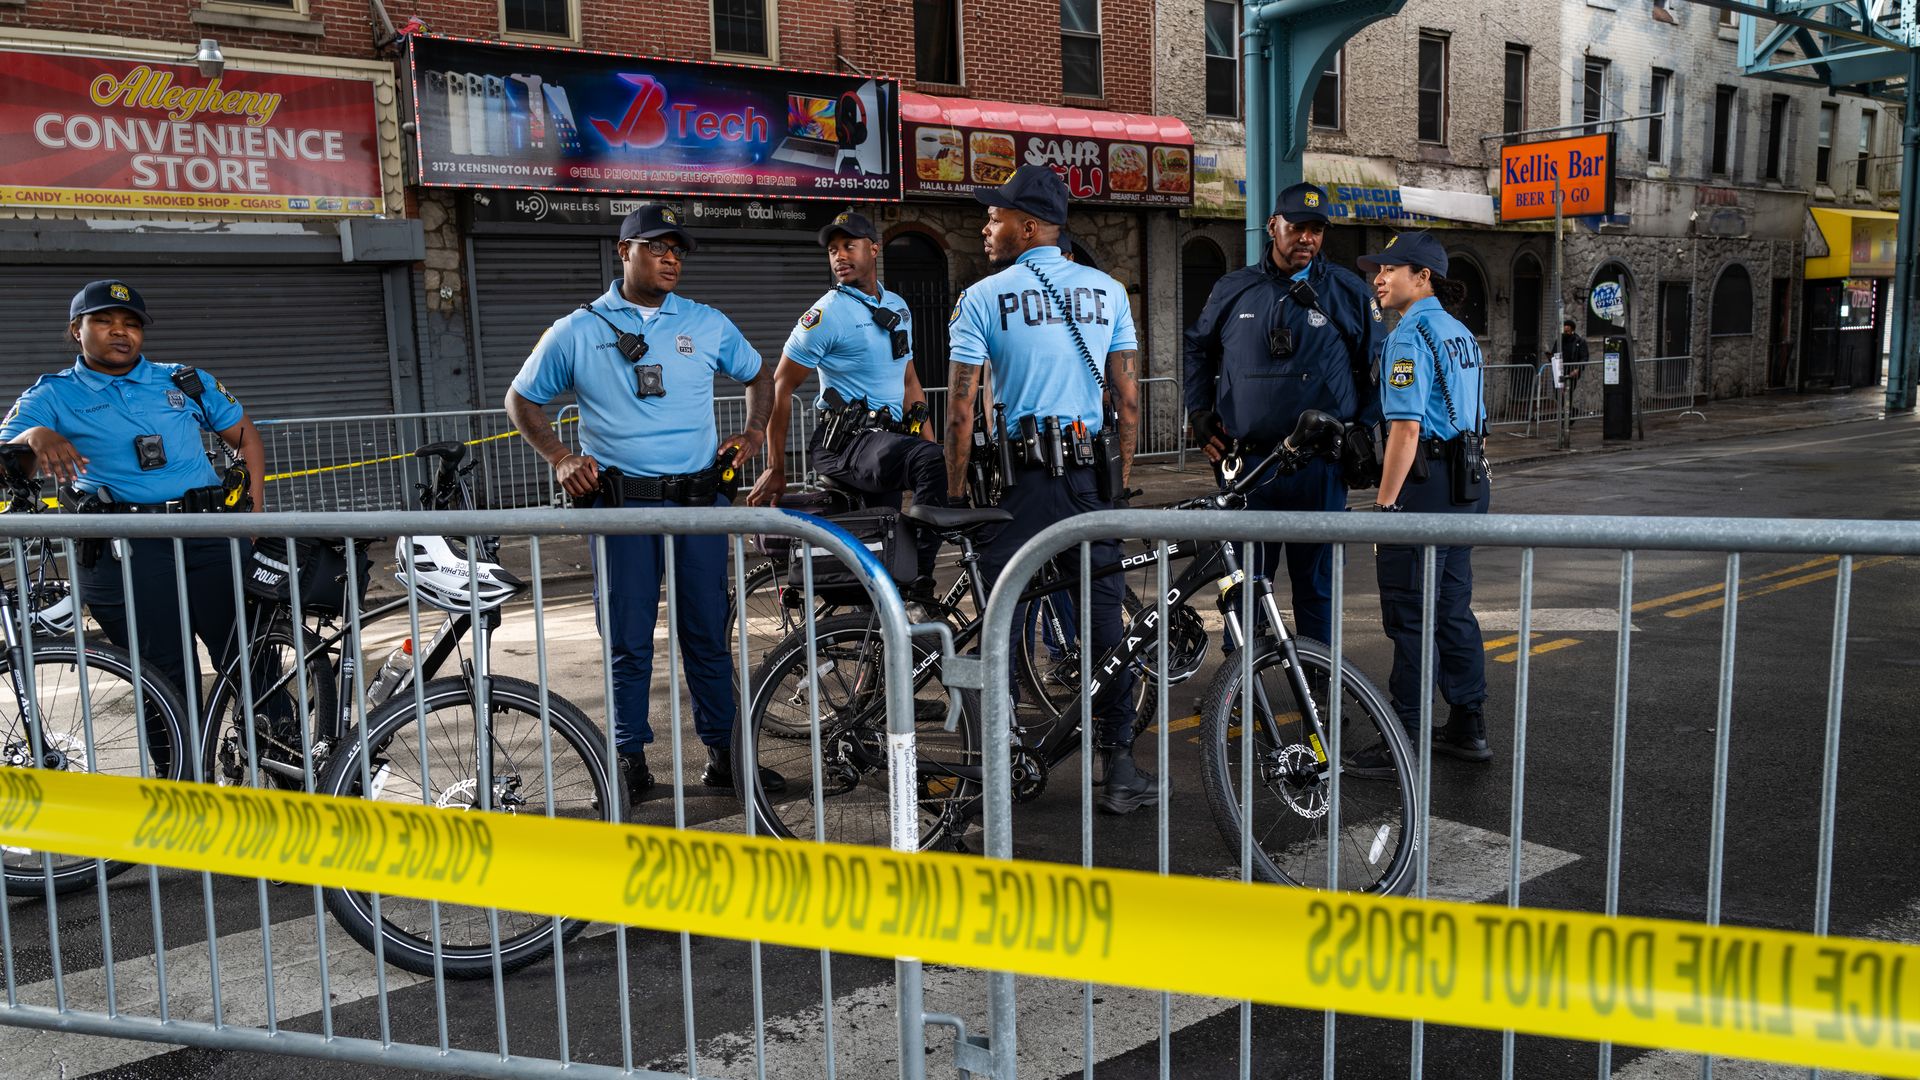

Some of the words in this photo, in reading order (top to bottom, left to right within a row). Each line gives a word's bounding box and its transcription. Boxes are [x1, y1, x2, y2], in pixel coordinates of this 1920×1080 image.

[90, 66, 281, 126] Allegheny
[671, 103, 769, 143] Tech
[34, 113, 345, 161] CONVENIENCE
[1024, 137, 1101, 167] SAHR
[1194, 154, 1218, 167] atural
[131, 154, 270, 192] STORE
[432, 161, 456, 172] 3173
[458, 163, 531, 176] KENSINGTON
[533, 166, 557, 177] AVE.
[570, 167, 601, 179] CELL
[604, 168, 648, 181] PHONE
[650, 170, 679, 182] AND
[681, 172, 754, 185] ELECTRONIC
[756, 175, 797, 187] REPAIR
[814, 176, 890, 190] 267-951-3020
[1504, 153, 1558, 185] Kellis
[1567, 150, 1604, 179] Bar
[919, 181, 945, 191] HALAL
[1048, 163, 1104, 199] ELI
[15, 190, 62, 203] CANDY
[74, 193, 131, 204] HOOKAH
[143, 195, 195, 207] SMOKED
[198, 197, 230, 208] SHOP
[240, 198, 282, 209] CIGARS
[290, 200, 310, 208] ATM
[1110, 192, 1140, 201] BREAKFAST
[1146, 194, 1165, 202] LUNCH
[1169, 195, 1190, 203] DINNER
[1337, 186, 1402, 203] SPECIA
[1515, 191, 1545, 207] BEER
[1571, 187, 1590, 203] GO
[550, 203, 600, 212] WIRELESS
[704, 206, 742, 218] pageplus
[747, 205, 774, 219] total
[774, 209, 807, 220] Wireless
[997, 287, 1109, 331] POLICE
[1394, 365, 1413, 374] POLICE
[1121, 543, 1179, 569] POLIE
[252, 567, 282, 585] POLICE
[912, 650, 940, 678] LICE
